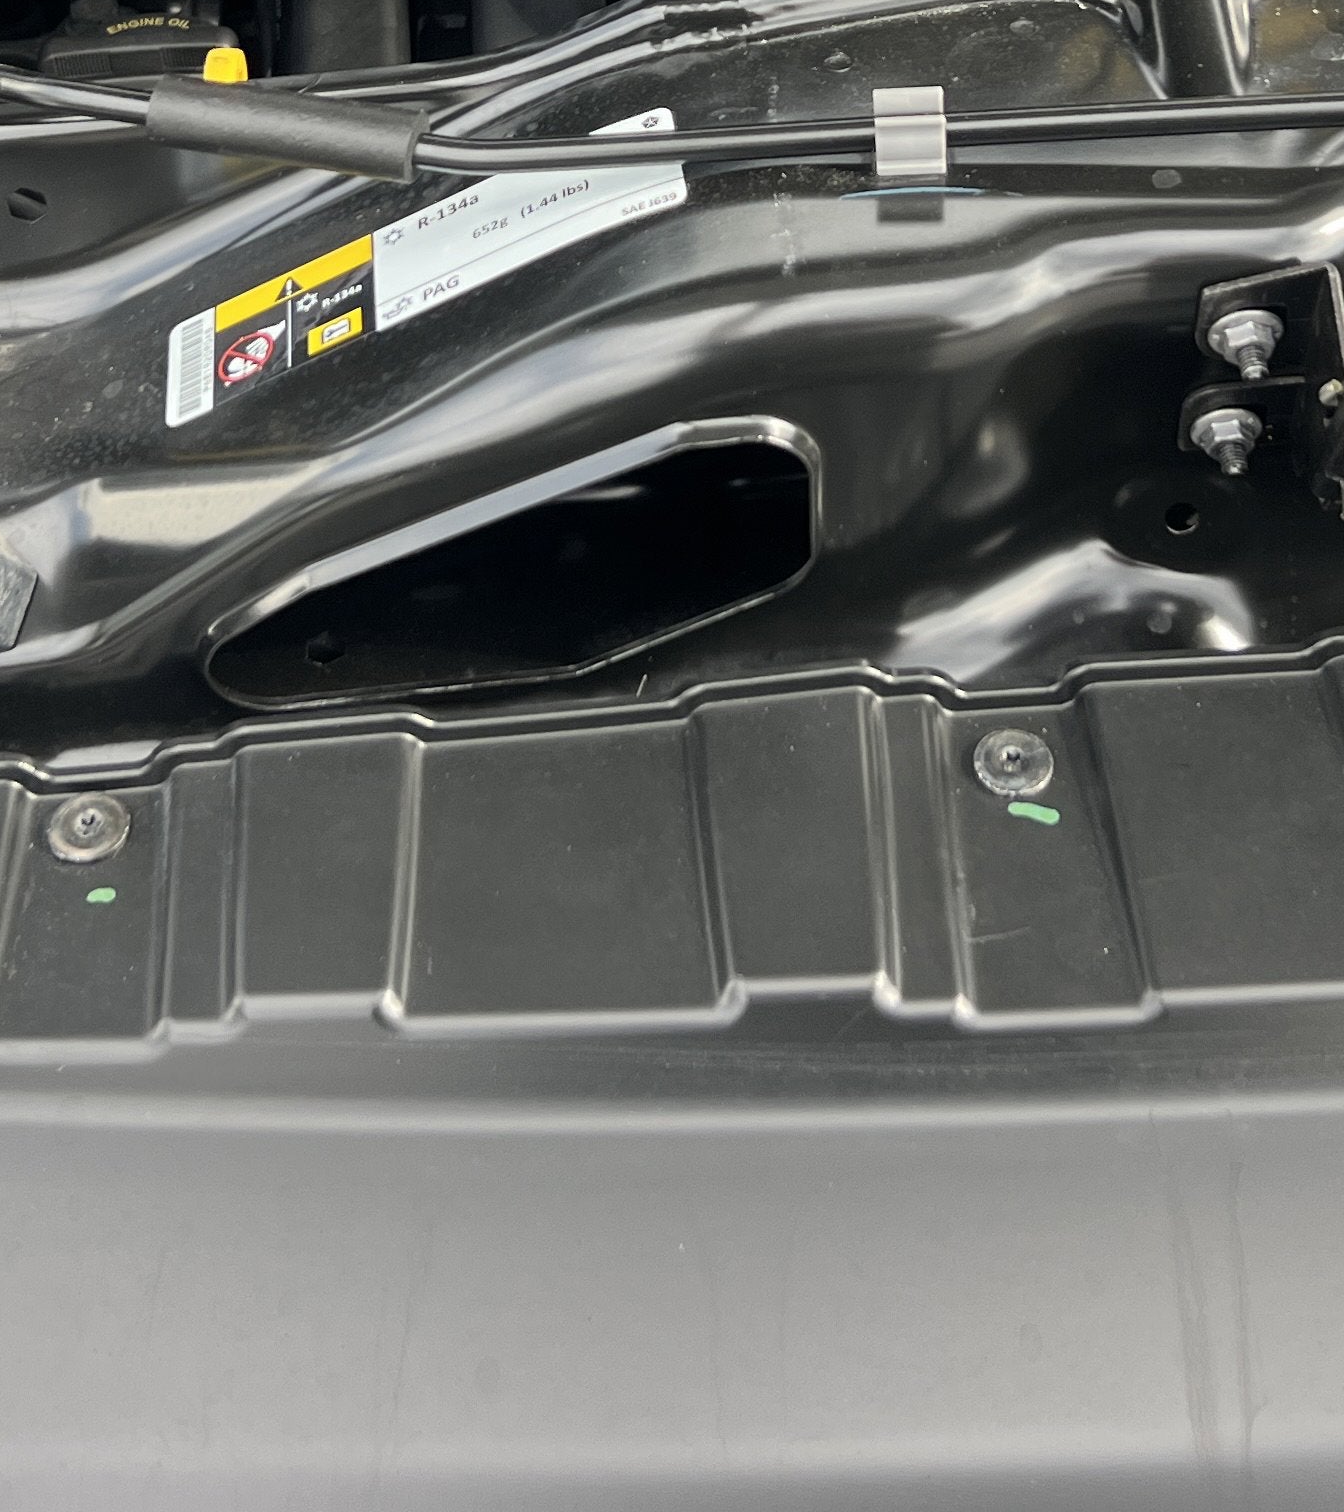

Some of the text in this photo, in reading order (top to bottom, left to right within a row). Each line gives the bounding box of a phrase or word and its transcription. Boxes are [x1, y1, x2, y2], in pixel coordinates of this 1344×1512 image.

[106, 16, 191, 36] ENGINE OIL
[418, 194, 479, 230] R-134a
[472, 179, 589, 239] 652g (1.44 lbs)
[622, 200, 647, 216] SAE
[423, 275, 460, 301] PAG
